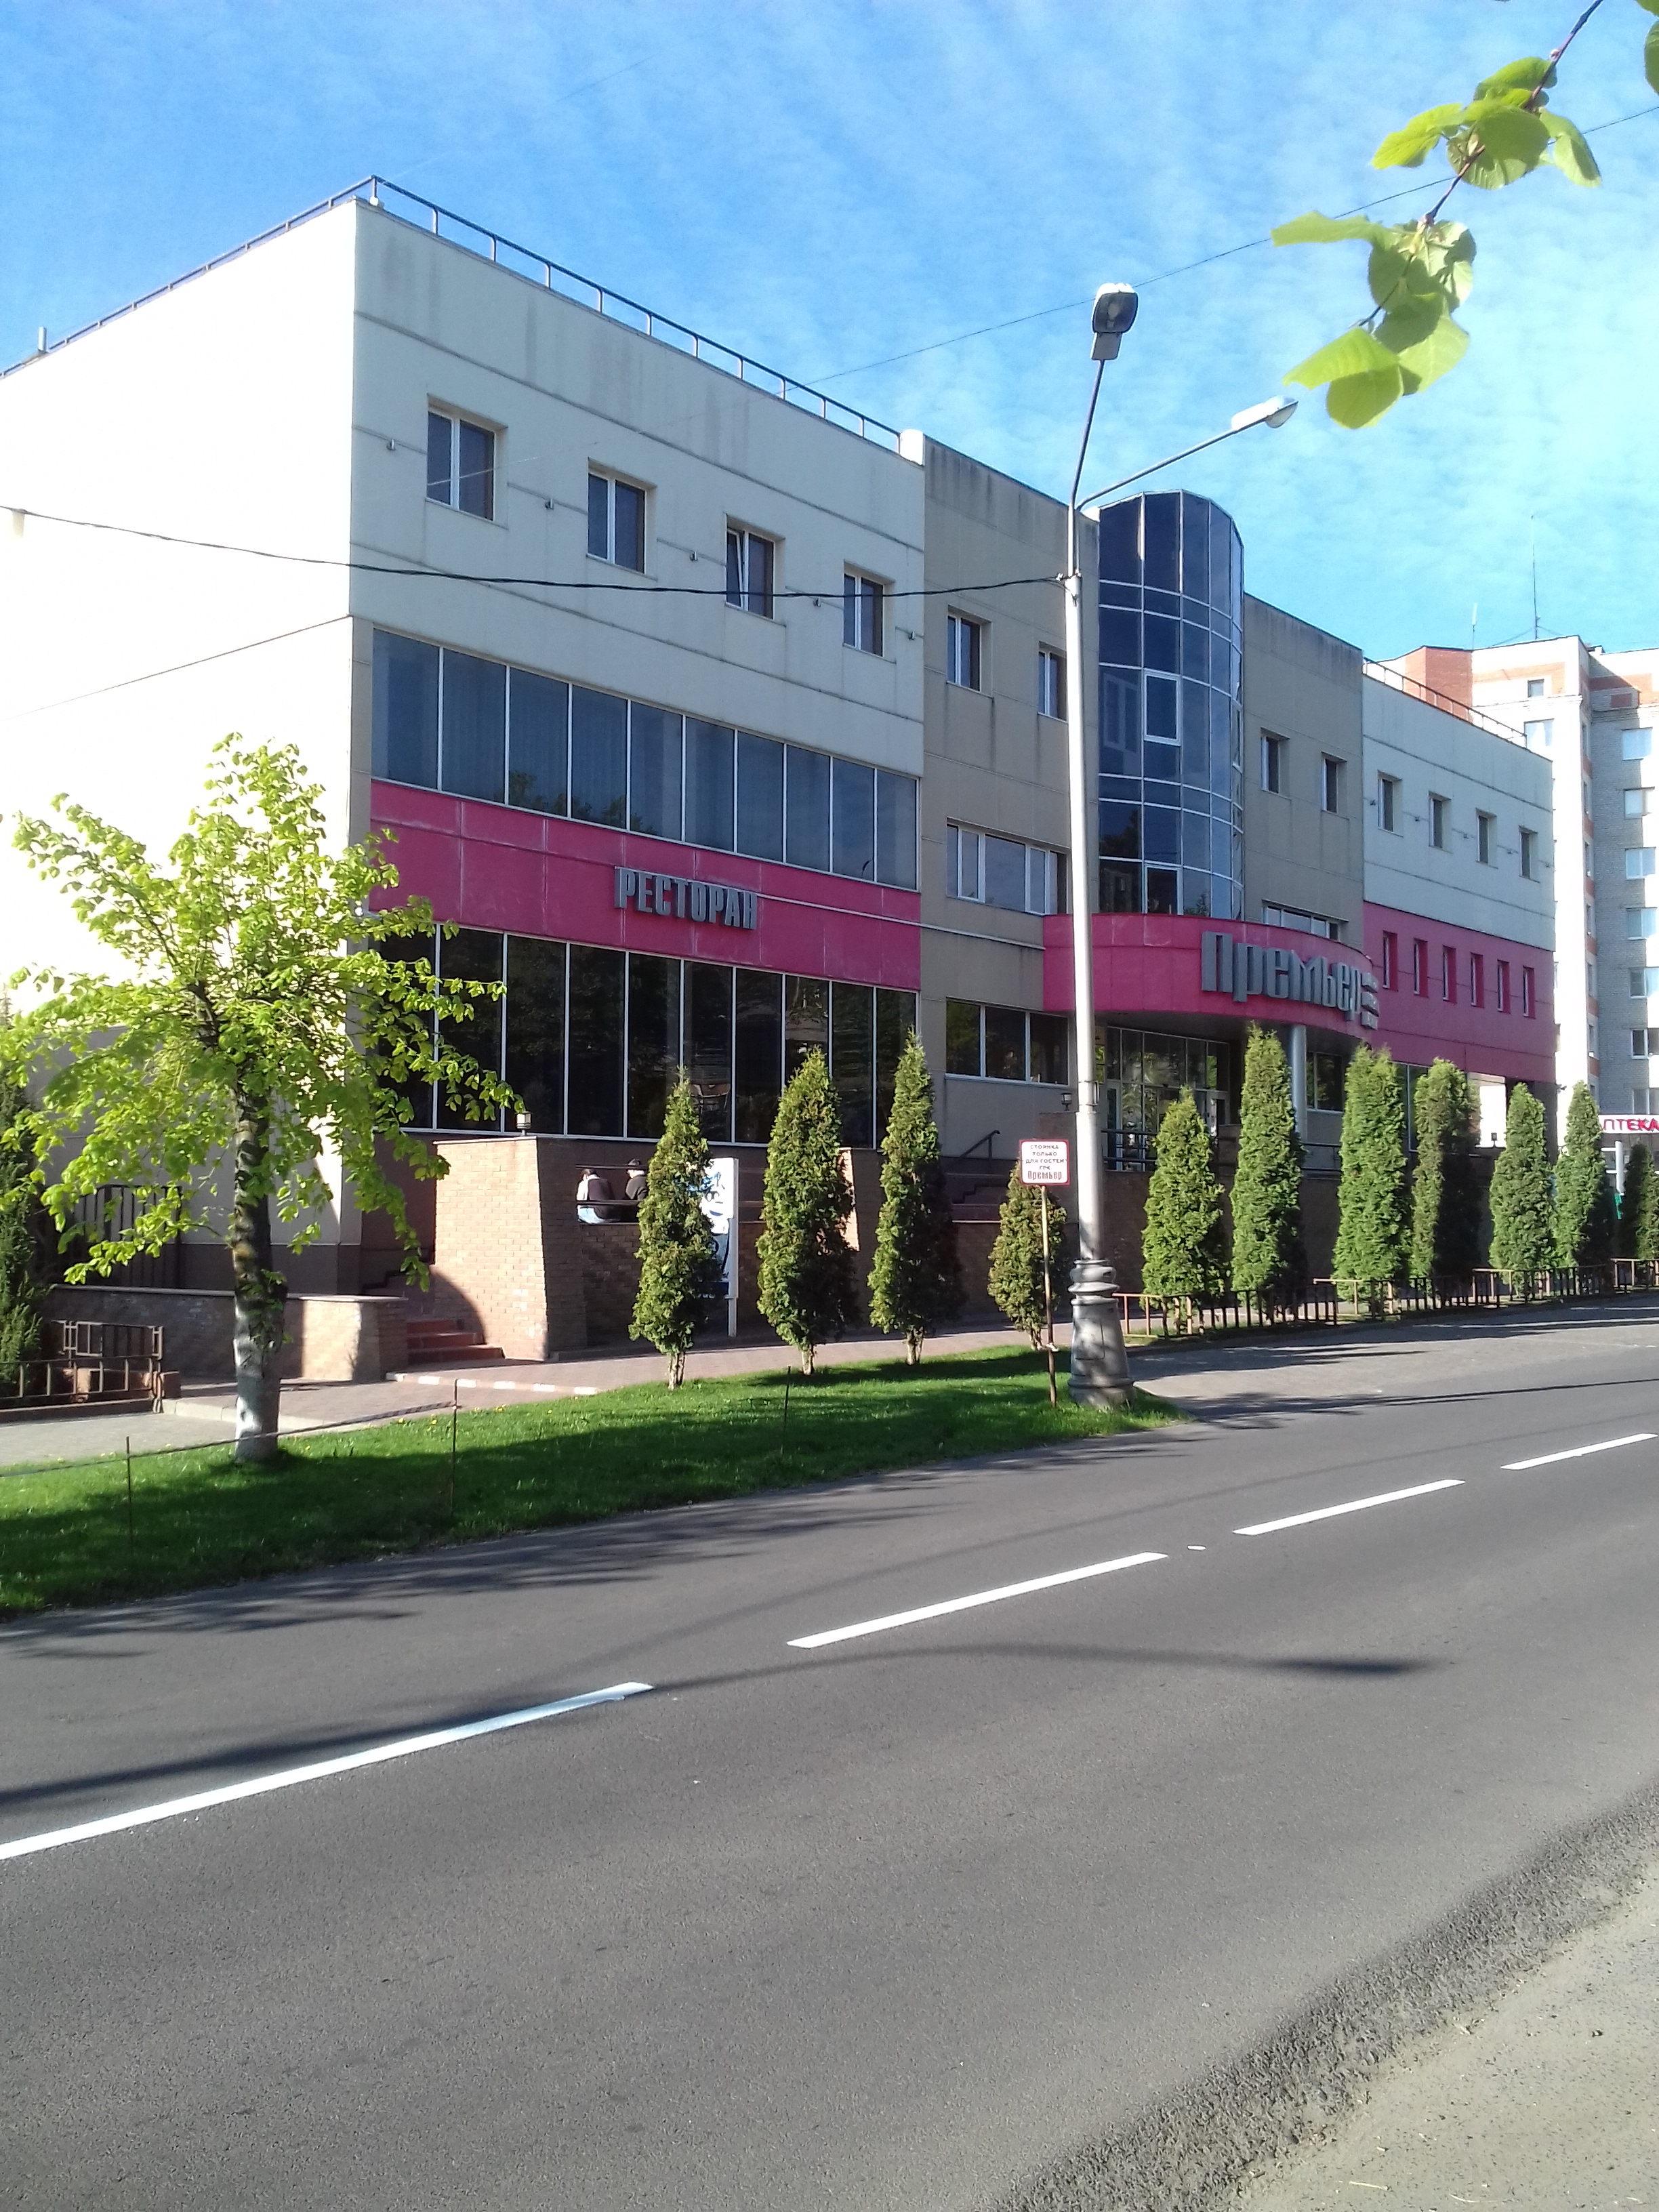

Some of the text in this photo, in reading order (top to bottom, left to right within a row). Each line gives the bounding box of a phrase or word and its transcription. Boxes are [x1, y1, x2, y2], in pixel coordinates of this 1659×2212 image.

[614, 867, 758, 929] РЕСТОРАН
[1201, 930, 1361, 1021] Премьер
[1602, 1118, 1659, 1132] ПТЕКА
[1027, 1170, 1062, 1181] Премьер
